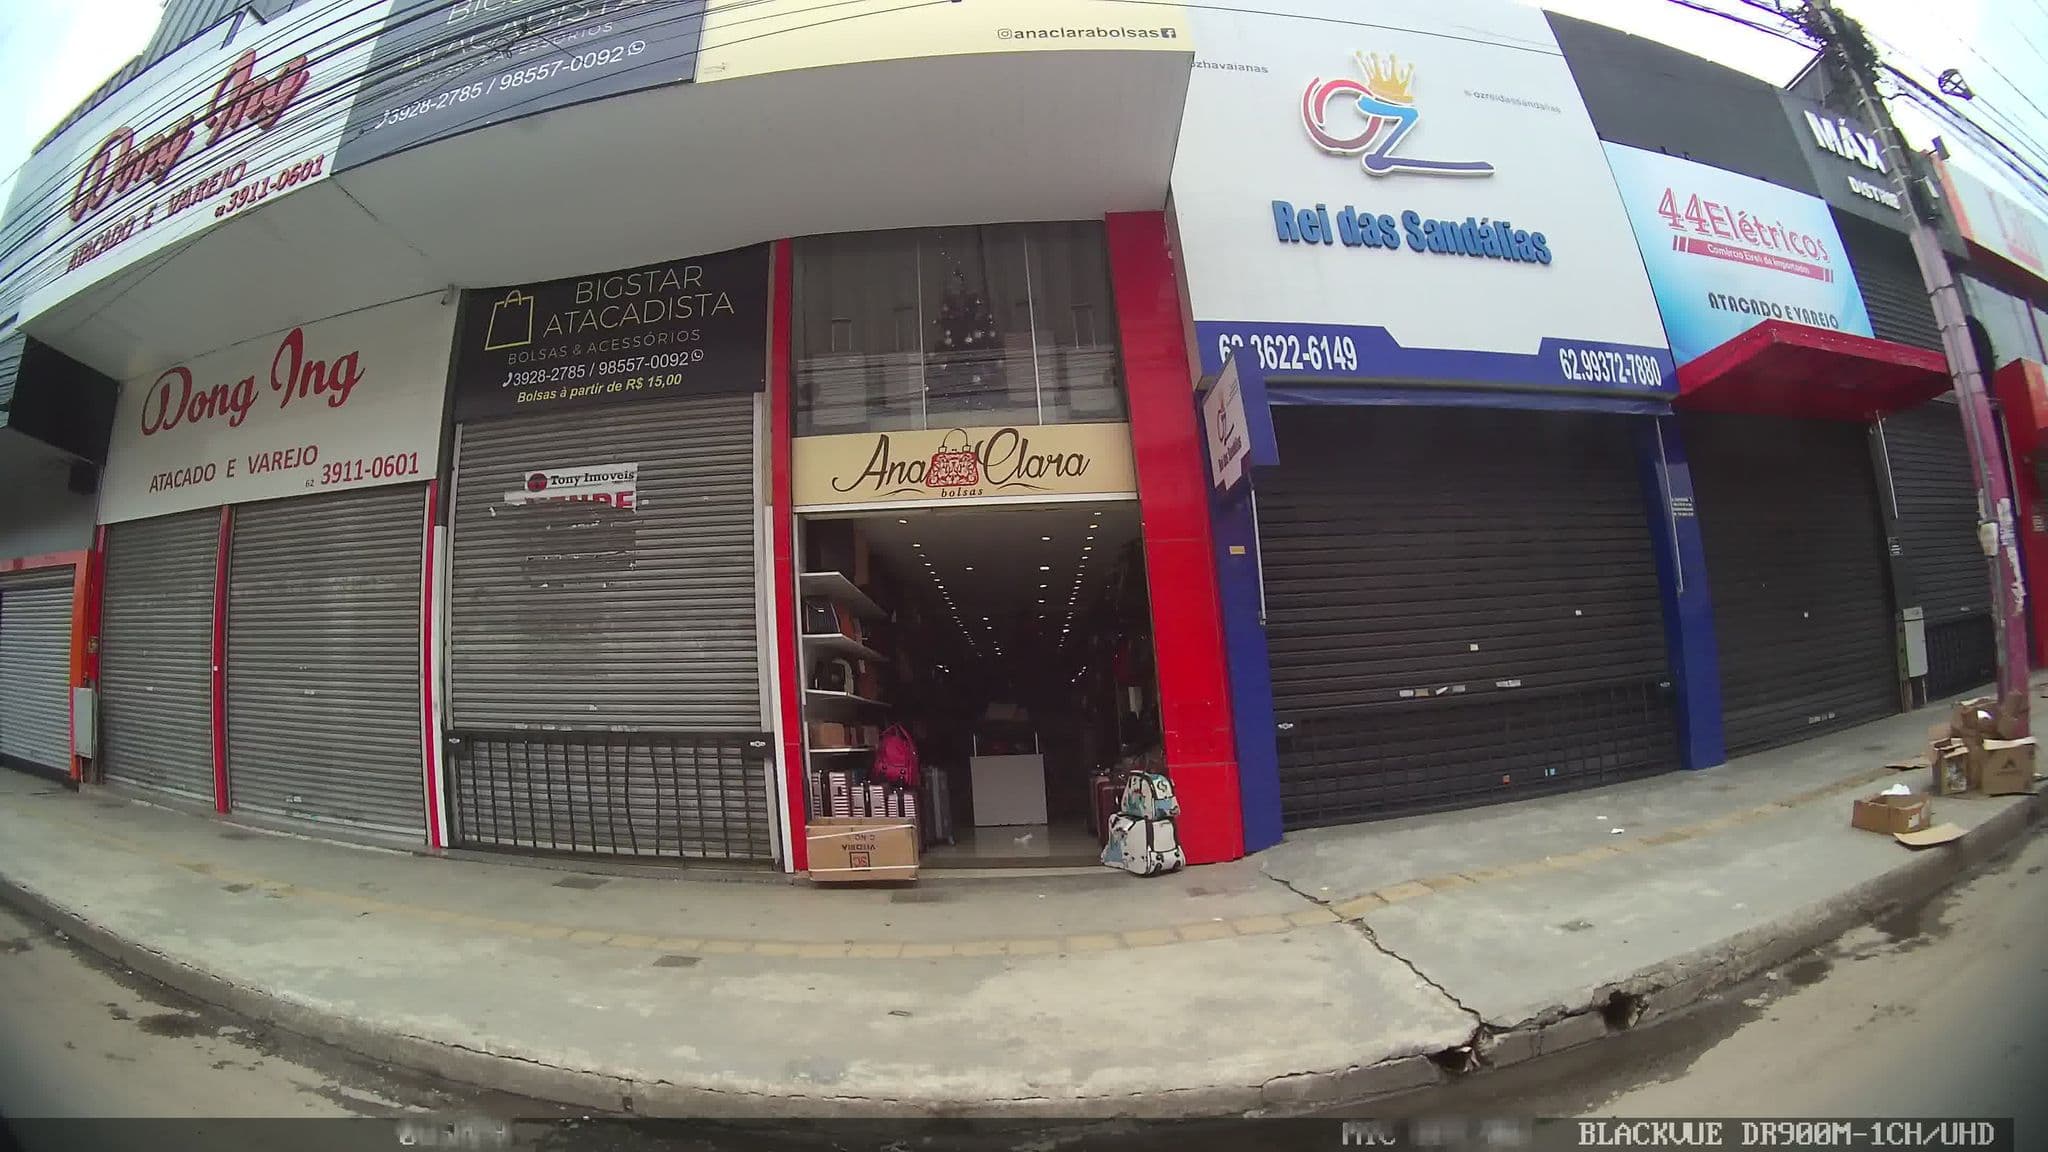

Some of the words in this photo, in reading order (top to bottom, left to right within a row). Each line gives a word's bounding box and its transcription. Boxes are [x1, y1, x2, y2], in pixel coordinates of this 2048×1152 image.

[1014, 26, 1159, 40] anaclarabolsas
[500, 46, 624, 91] 98557-0092
[69, 115, 195, 221] Dong
[205, 48, 310, 147] Ing
[226, 154, 325, 212] 3911-0601
[1272, 200, 1333, 245] Rei
[1337, 205, 1401, 249] das
[1402, 208, 1552, 266] Sandálias
[575, 266, 703, 304] BIGSTAR
[543, 292, 735, 338] ATACADISTA
[1708, 292, 1782, 319] ATACADO
[1785, 305, 1793, 320] E
[1795, 307, 1839, 329] VAREJO
[508, 345, 568, 366] BOLSAS
[573, 343, 581, 355] &
[587, 329, 701, 354] ACESSÓRIOS
[1559, 347, 1662, 386] 62.99372-7880
[141, 366, 259, 436] Dong
[270, 327, 365, 409] Ing
[512, 364, 586, 387] 3928-2785
[589, 363, 595, 377] /
[598, 351, 689, 376] 98557-0092
[517, 389, 556, 403] Bolsas
[559, 386, 567, 398] à
[569, 384, 602, 402] partir
[607, 381, 622, 393] de
[625, 377, 643, 391] R$
[648, 373, 682, 389] 15,00
[150, 462, 216, 493] ATACADO
[226, 458, 237, 478] E
[248, 445, 318, 474] VAREJO
[305, 479, 315, 487] 62
[321, 452, 419, 485] 3911-0601
[551, 475, 580, 487] Tony
[584, 470, 635, 483] Imoveis
[832, 433, 929, 492] Ana
[976, 427, 1090, 485] Clara
[941, 486, 984, 498] bolsas
